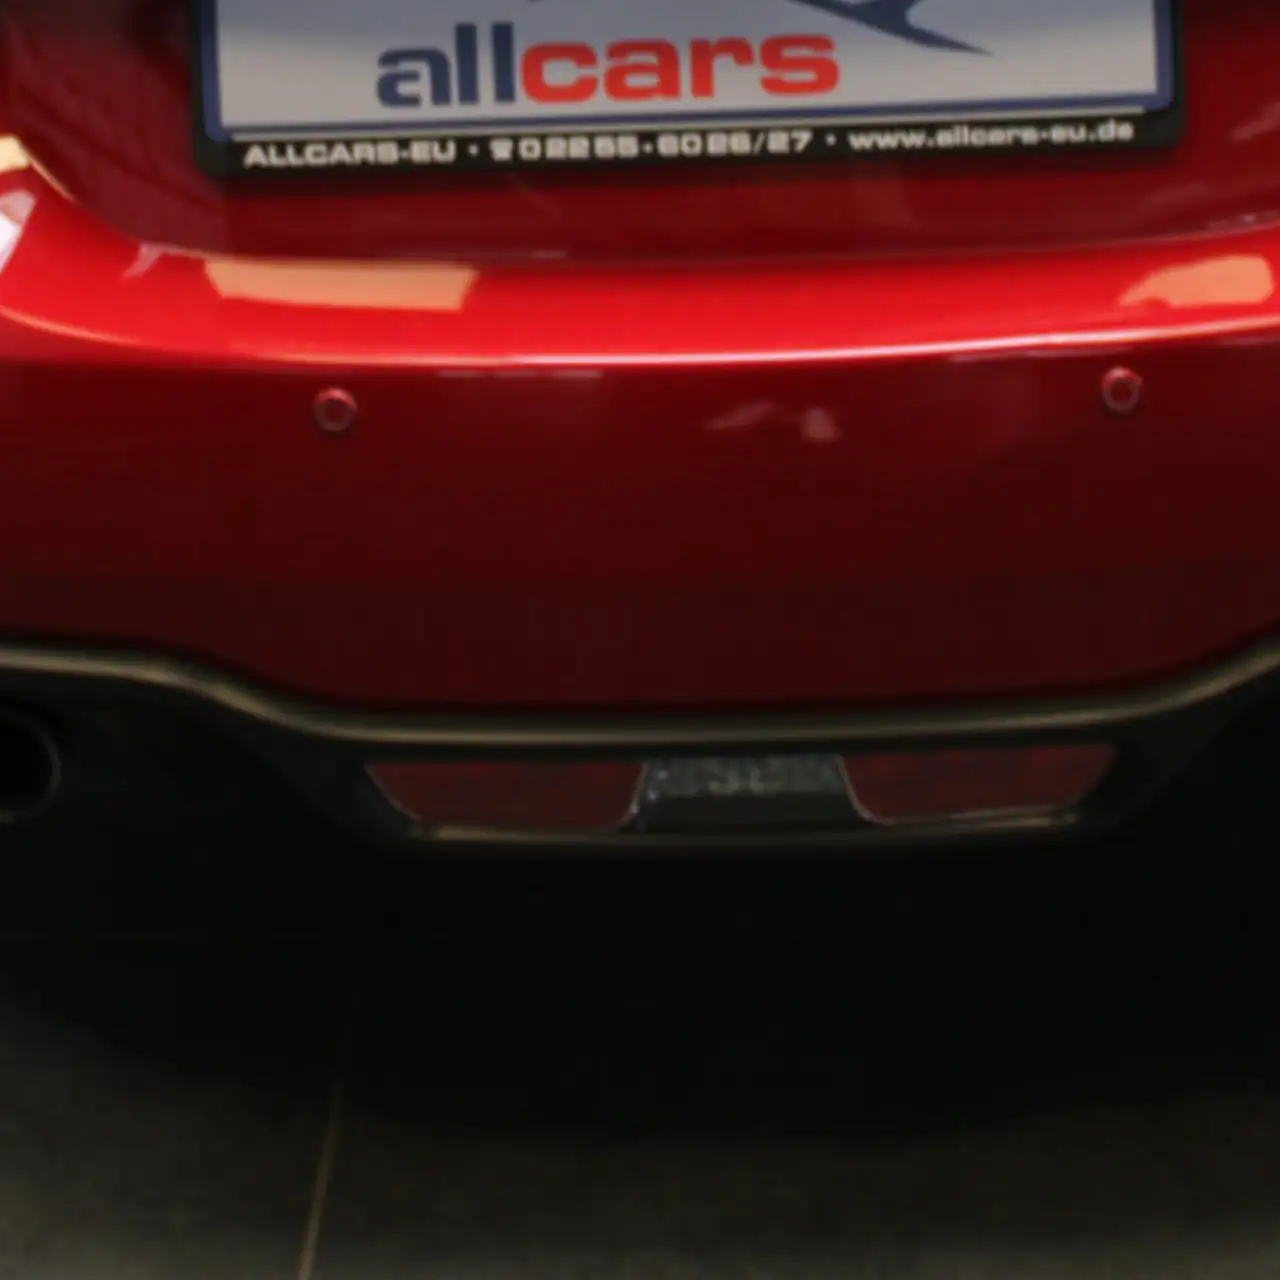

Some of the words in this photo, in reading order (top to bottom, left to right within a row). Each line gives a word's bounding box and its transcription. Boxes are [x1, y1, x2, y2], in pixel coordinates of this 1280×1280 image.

[376, 22, 841, 107] allcars
[243, 137, 457, 168] ALLCARS-EU
[847, 119, 1135, 151] www.allcars-eu.de
